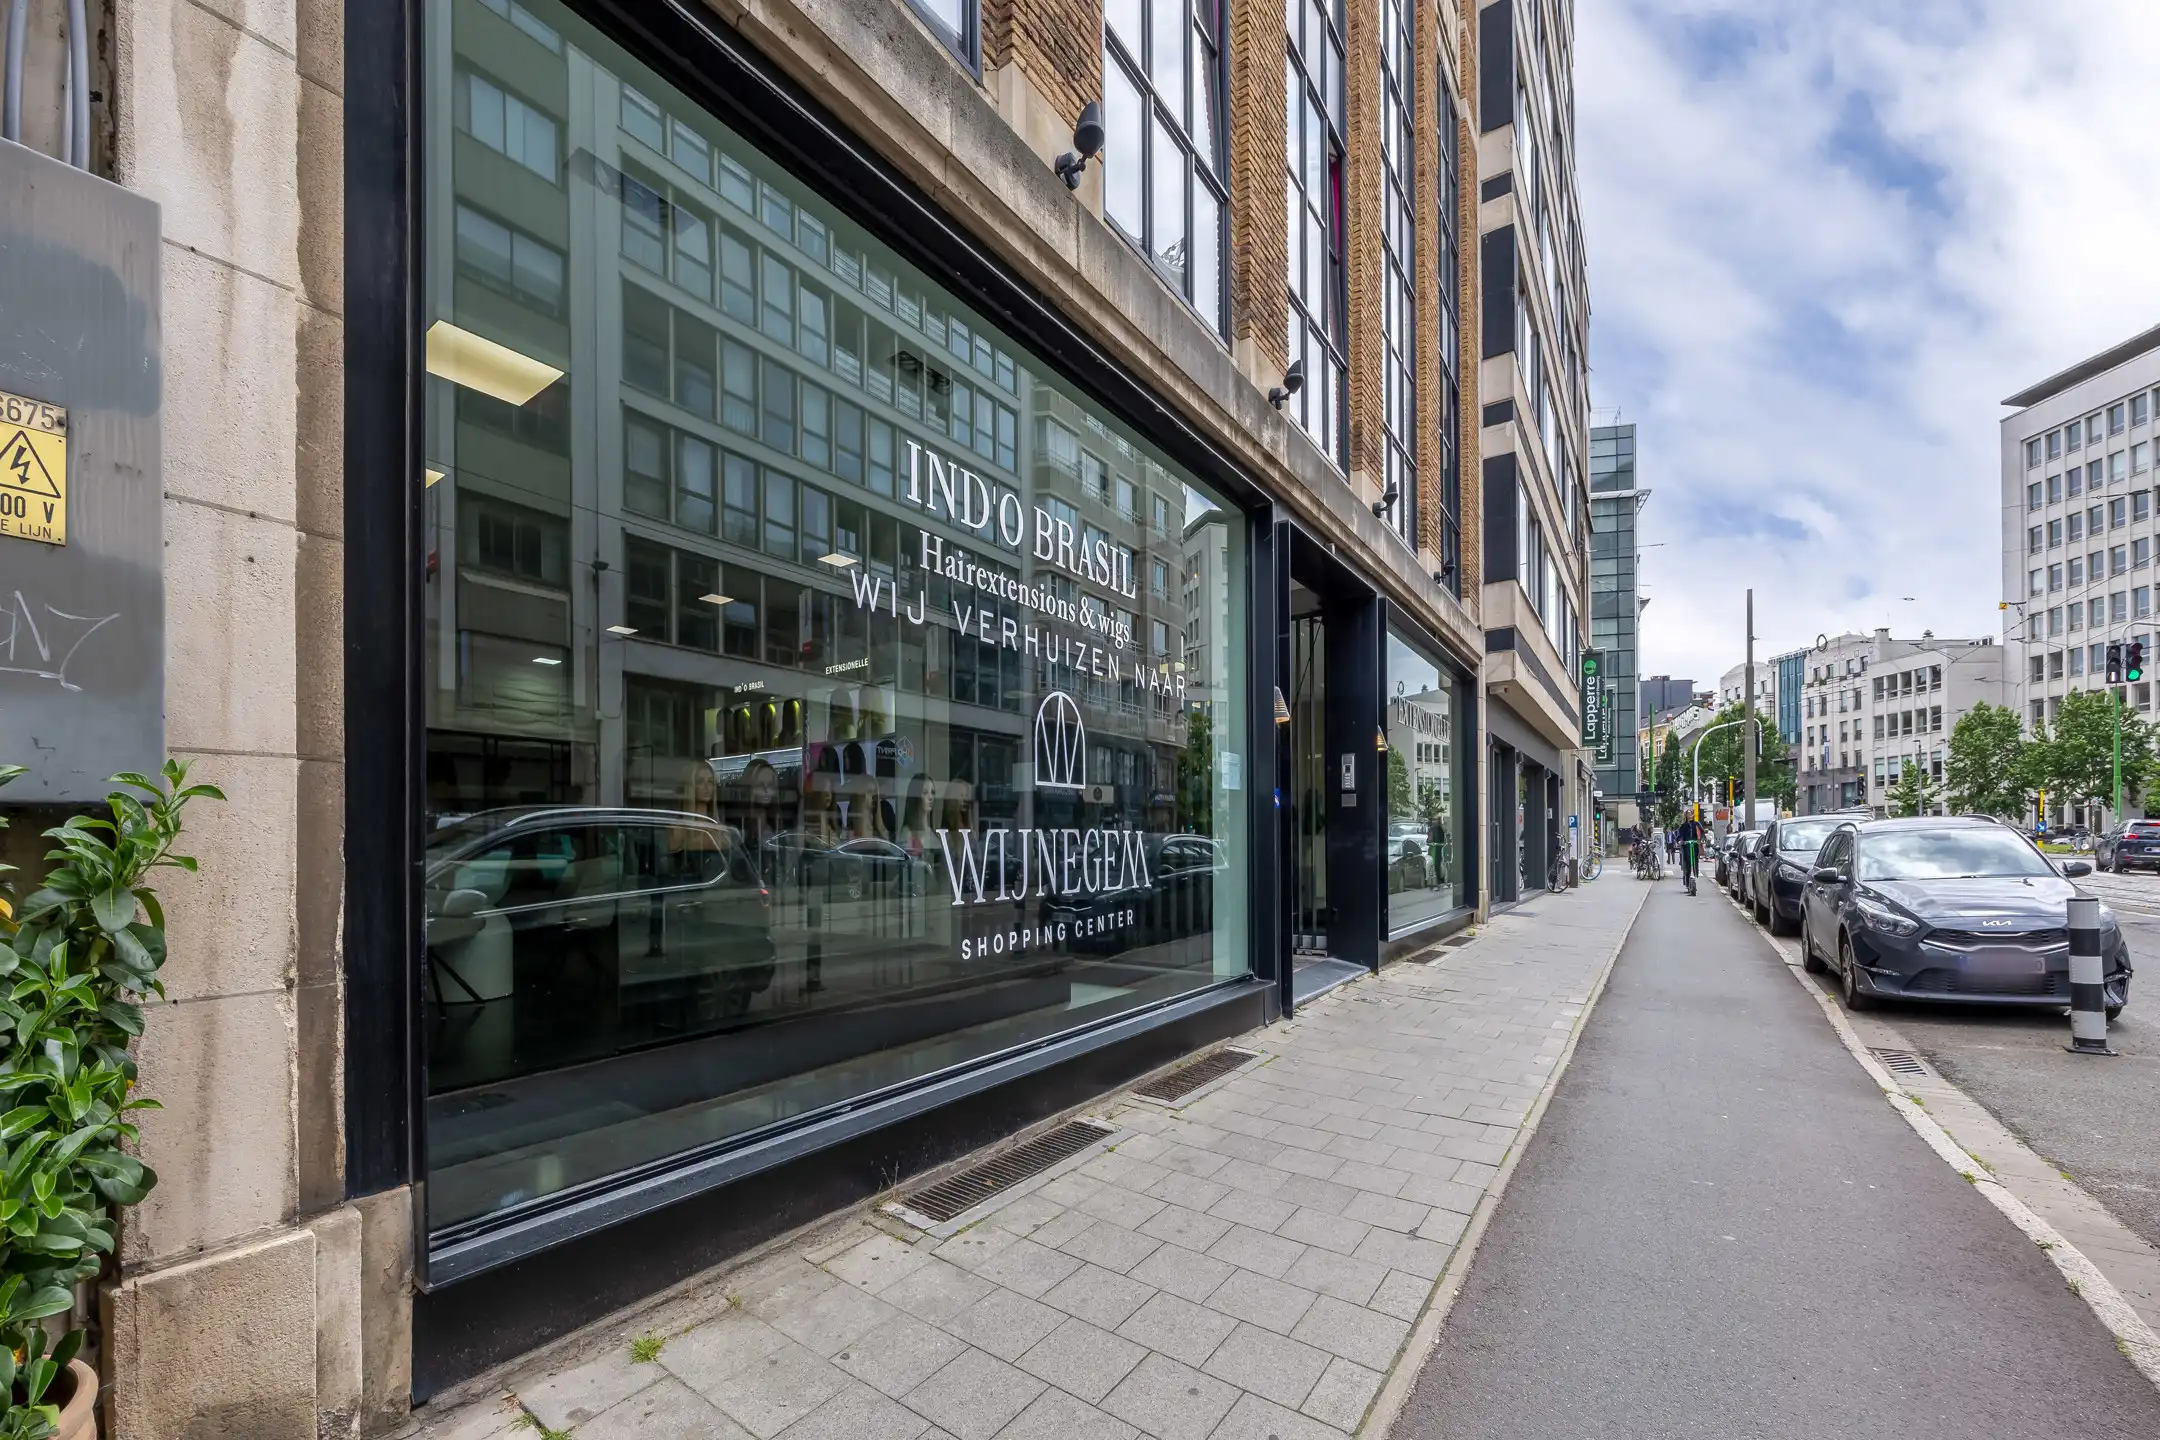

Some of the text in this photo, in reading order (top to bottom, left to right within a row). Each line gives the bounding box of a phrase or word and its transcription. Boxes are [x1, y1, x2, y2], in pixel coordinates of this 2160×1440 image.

[20, 522, 52, 539] LIJN
[42, 501, 55, 524] V
[906, 440, 1137, 600] IND'O BRASIL
[919, 529, 1131, 649] Hairextensions & wigs
[850, 569, 1187, 698] WIJ VERHUIZEN NAAR
[748, 680, 765, 690] BRASIL
[825, 657, 869, 675] EXTENSIONELLE
[1584, 676, 1599, 740] Lapperre
[935, 828, 1152, 905] WIJNEGEM
[961, 909, 1135, 960] SHOPPING CENTER
